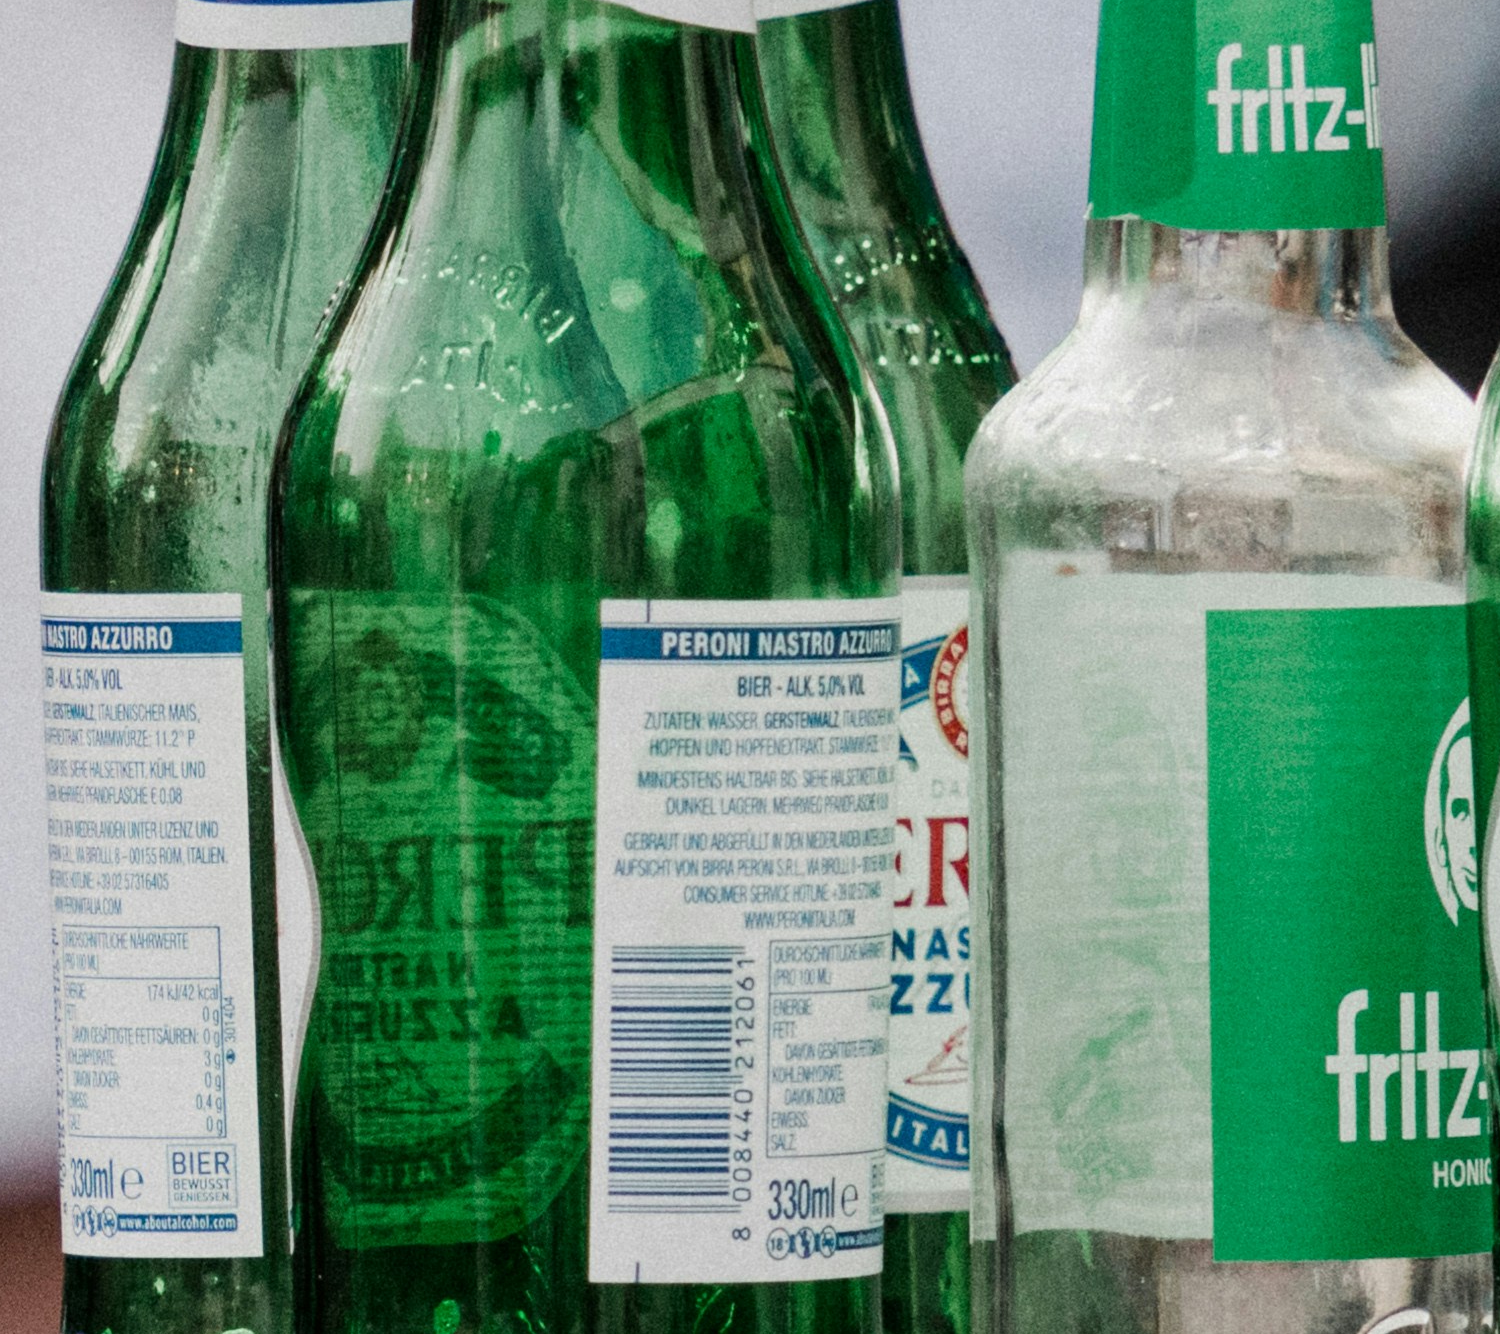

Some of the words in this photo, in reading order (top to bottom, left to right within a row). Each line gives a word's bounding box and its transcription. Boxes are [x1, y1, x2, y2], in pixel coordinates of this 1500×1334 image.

[91, 625, 174, 651] AZZURRO
[661, 631, 750, 657] PERONI
[757, 630, 835, 657] NASTRO
[839, 628, 892, 655] AZZURRO
[102, 669, 123, 690] VOL
[737, 675, 772, 698] BIER
[818, 674, 846, 700] 5,0%
[168, 704, 201, 724] MAIS,
[188, 729, 196, 748] P
[649, 738, 701, 757] HOPFEN
[705, 738, 732, 757] UND
[150, 757, 177, 779] KÜHL
[181, 760, 206, 779] UND
[638, 770, 722, 790] MINDESTENS
[725, 769, 778, 789] HALTBAR
[665, 797, 715, 816] DUNKEL
[128, 821, 156, 839] UNTER
[159, 821, 193, 839] LIZENZ
[196, 821, 219, 839] UND
[624, 832, 680, 851] GEBRAUT
[683, 832, 708, 851] UND
[129, 847, 157, 865] 00155
[614, 859, 672, 878] AUFSICHT
[675, 859, 699, 877] VON
[702, 858, 735, 877] BIRRA
[124, 872, 169, 891] 57316405
[684, 884, 748, 904] CONSUMER
[750, 883, 789, 903] SERVICE
[130, 928, 189, 950] NÄHRWERTE
[891, 926, 970, 962] NAS
[147, 984, 164, 1001] 174
[198, 983, 218, 1001] kcal
[890, 971, 970, 1016] ZZ
[213, 1009, 219, 1026] g
[223, 996, 236, 1043] 301404
[735, 958, 755, 1069] 212061
[214, 1031, 220, 1048] g
[205, 1051, 211, 1067] 3
[214, 1053, 221, 1071] g
[215, 1075, 222, 1092] g
[215, 1096, 222, 1114] g
[216, 1119, 223, 1137] g
[890, 1113, 968, 1157] ITAL
[732, 1089, 754, 1203] 008440
[172, 1151, 231, 1176] BIER
[172, 1178, 232, 1191] BEWUSST
[768, 1176, 835, 1221] 330ml
[119, 1214, 237, 1232] www.aboutalcohol.com
[732, 1226, 751, 1241] 8
